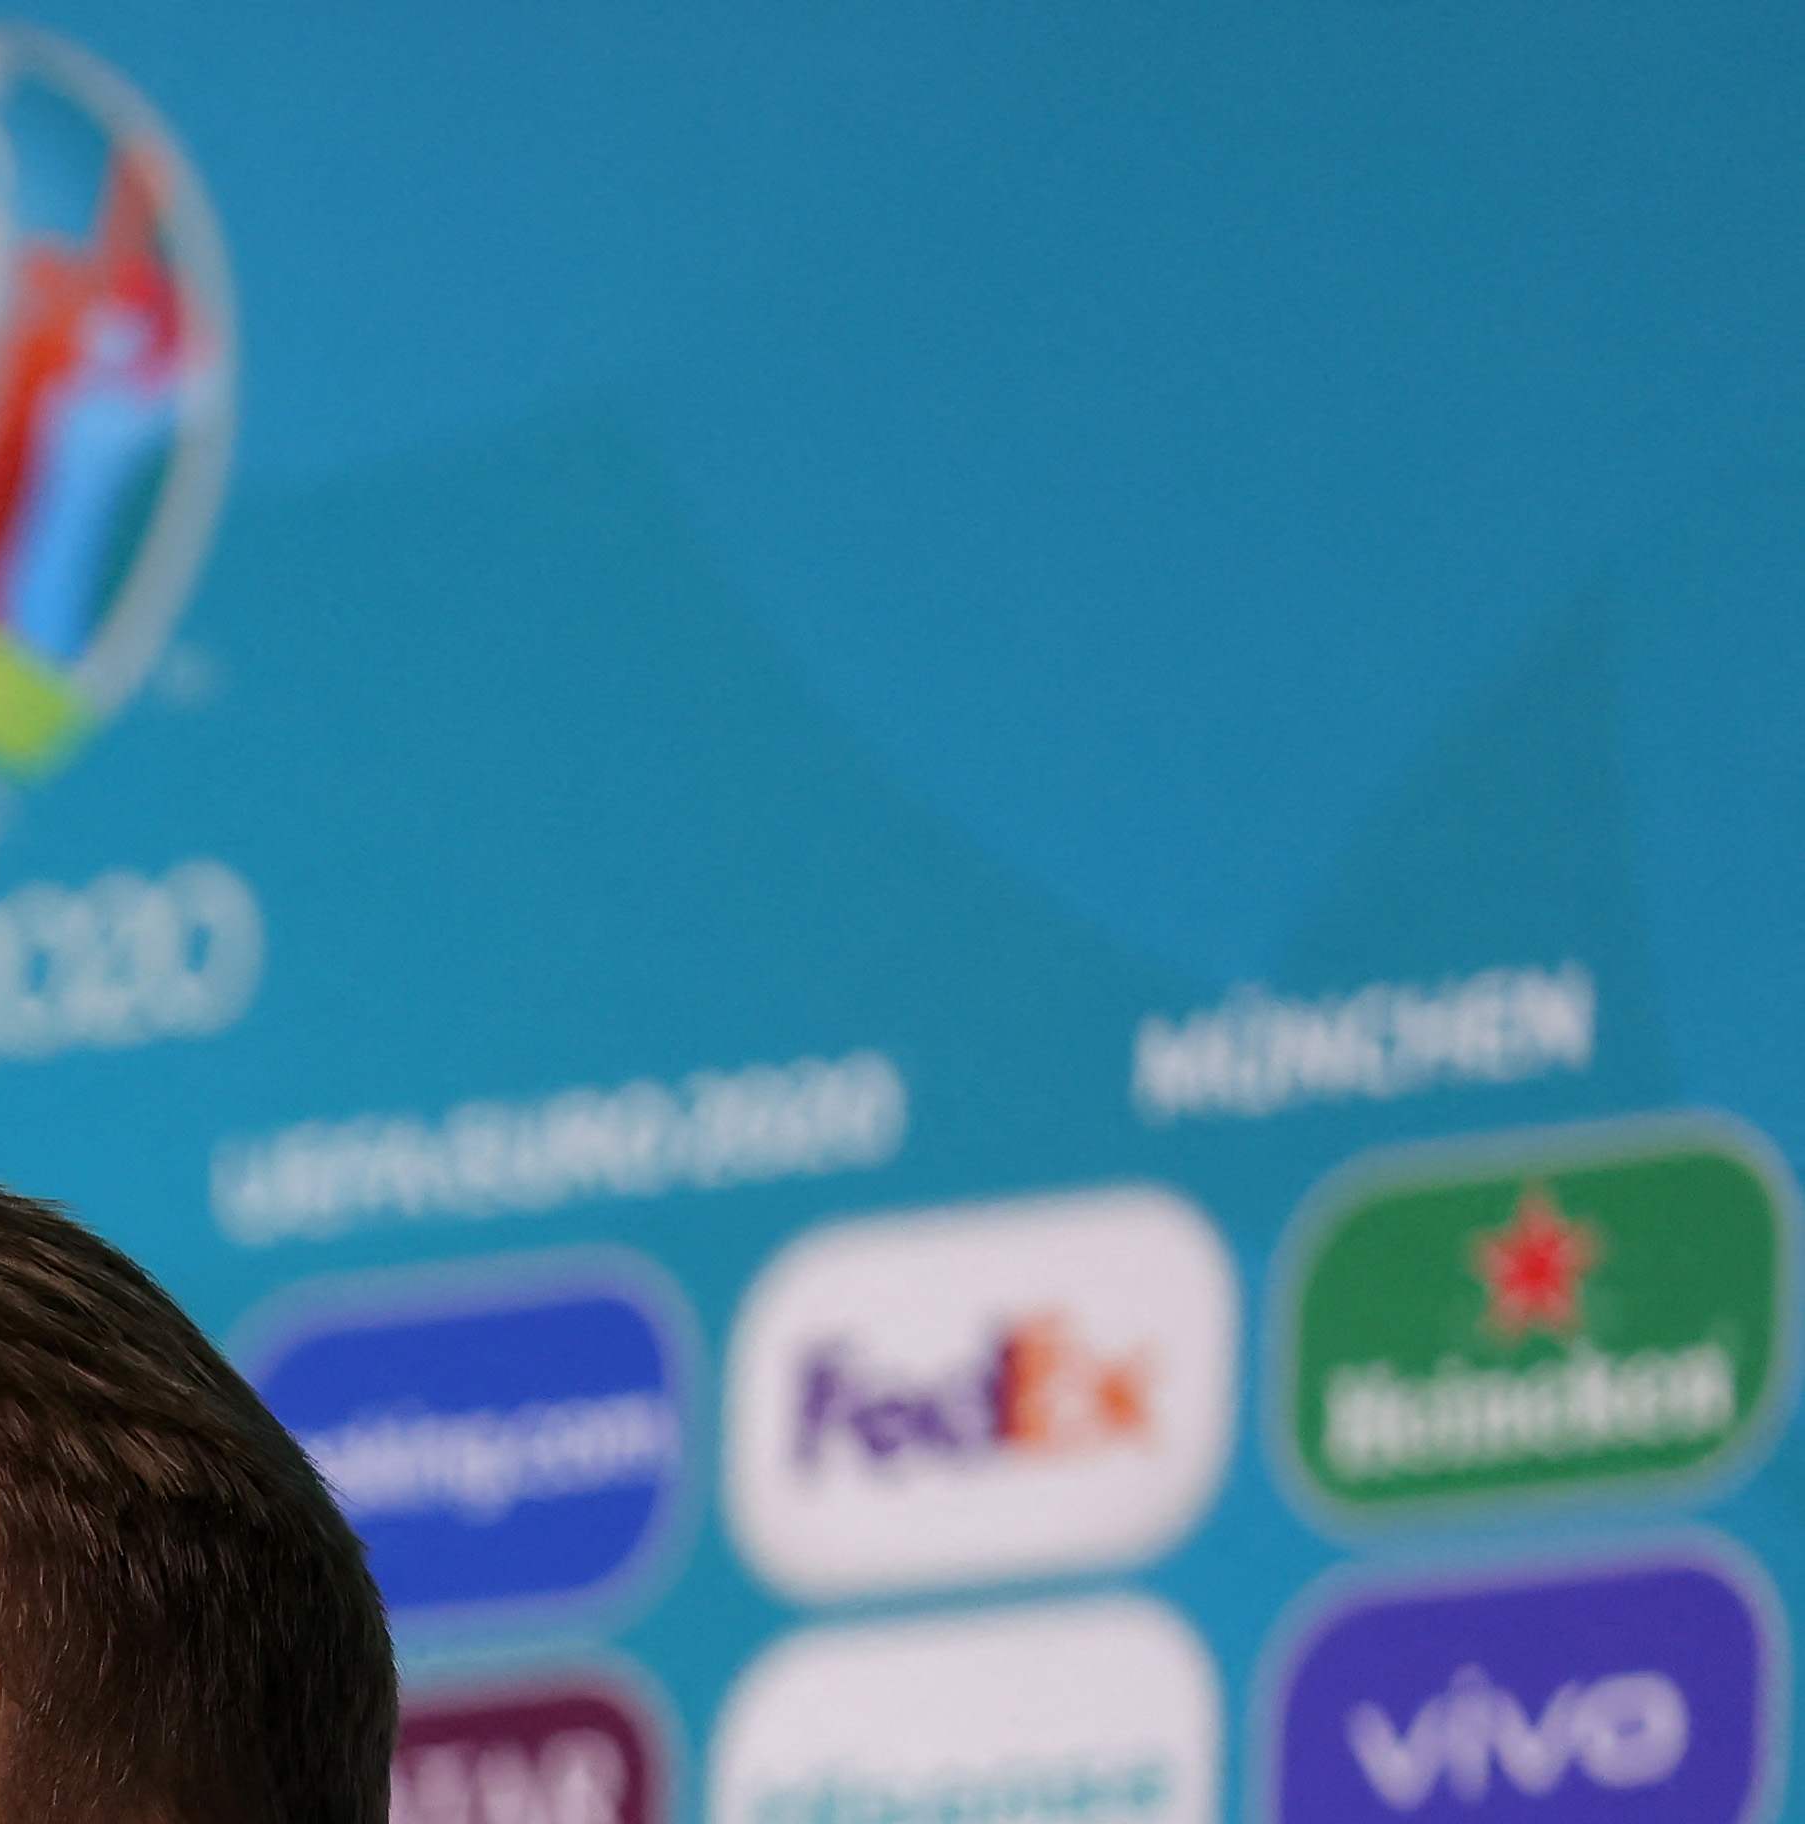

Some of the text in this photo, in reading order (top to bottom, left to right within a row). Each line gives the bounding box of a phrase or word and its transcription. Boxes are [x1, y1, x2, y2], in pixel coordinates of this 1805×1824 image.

[1141, 968, 1587, 1118] MÜNCHEN
[218, 1058, 899, 1239] UEFA EURO 2020
[801, 1311, 1155, 1468] FedEx
[1331, 1343, 1727, 1474] Heineken
[1352, 1668, 1682, 1806] vivo
